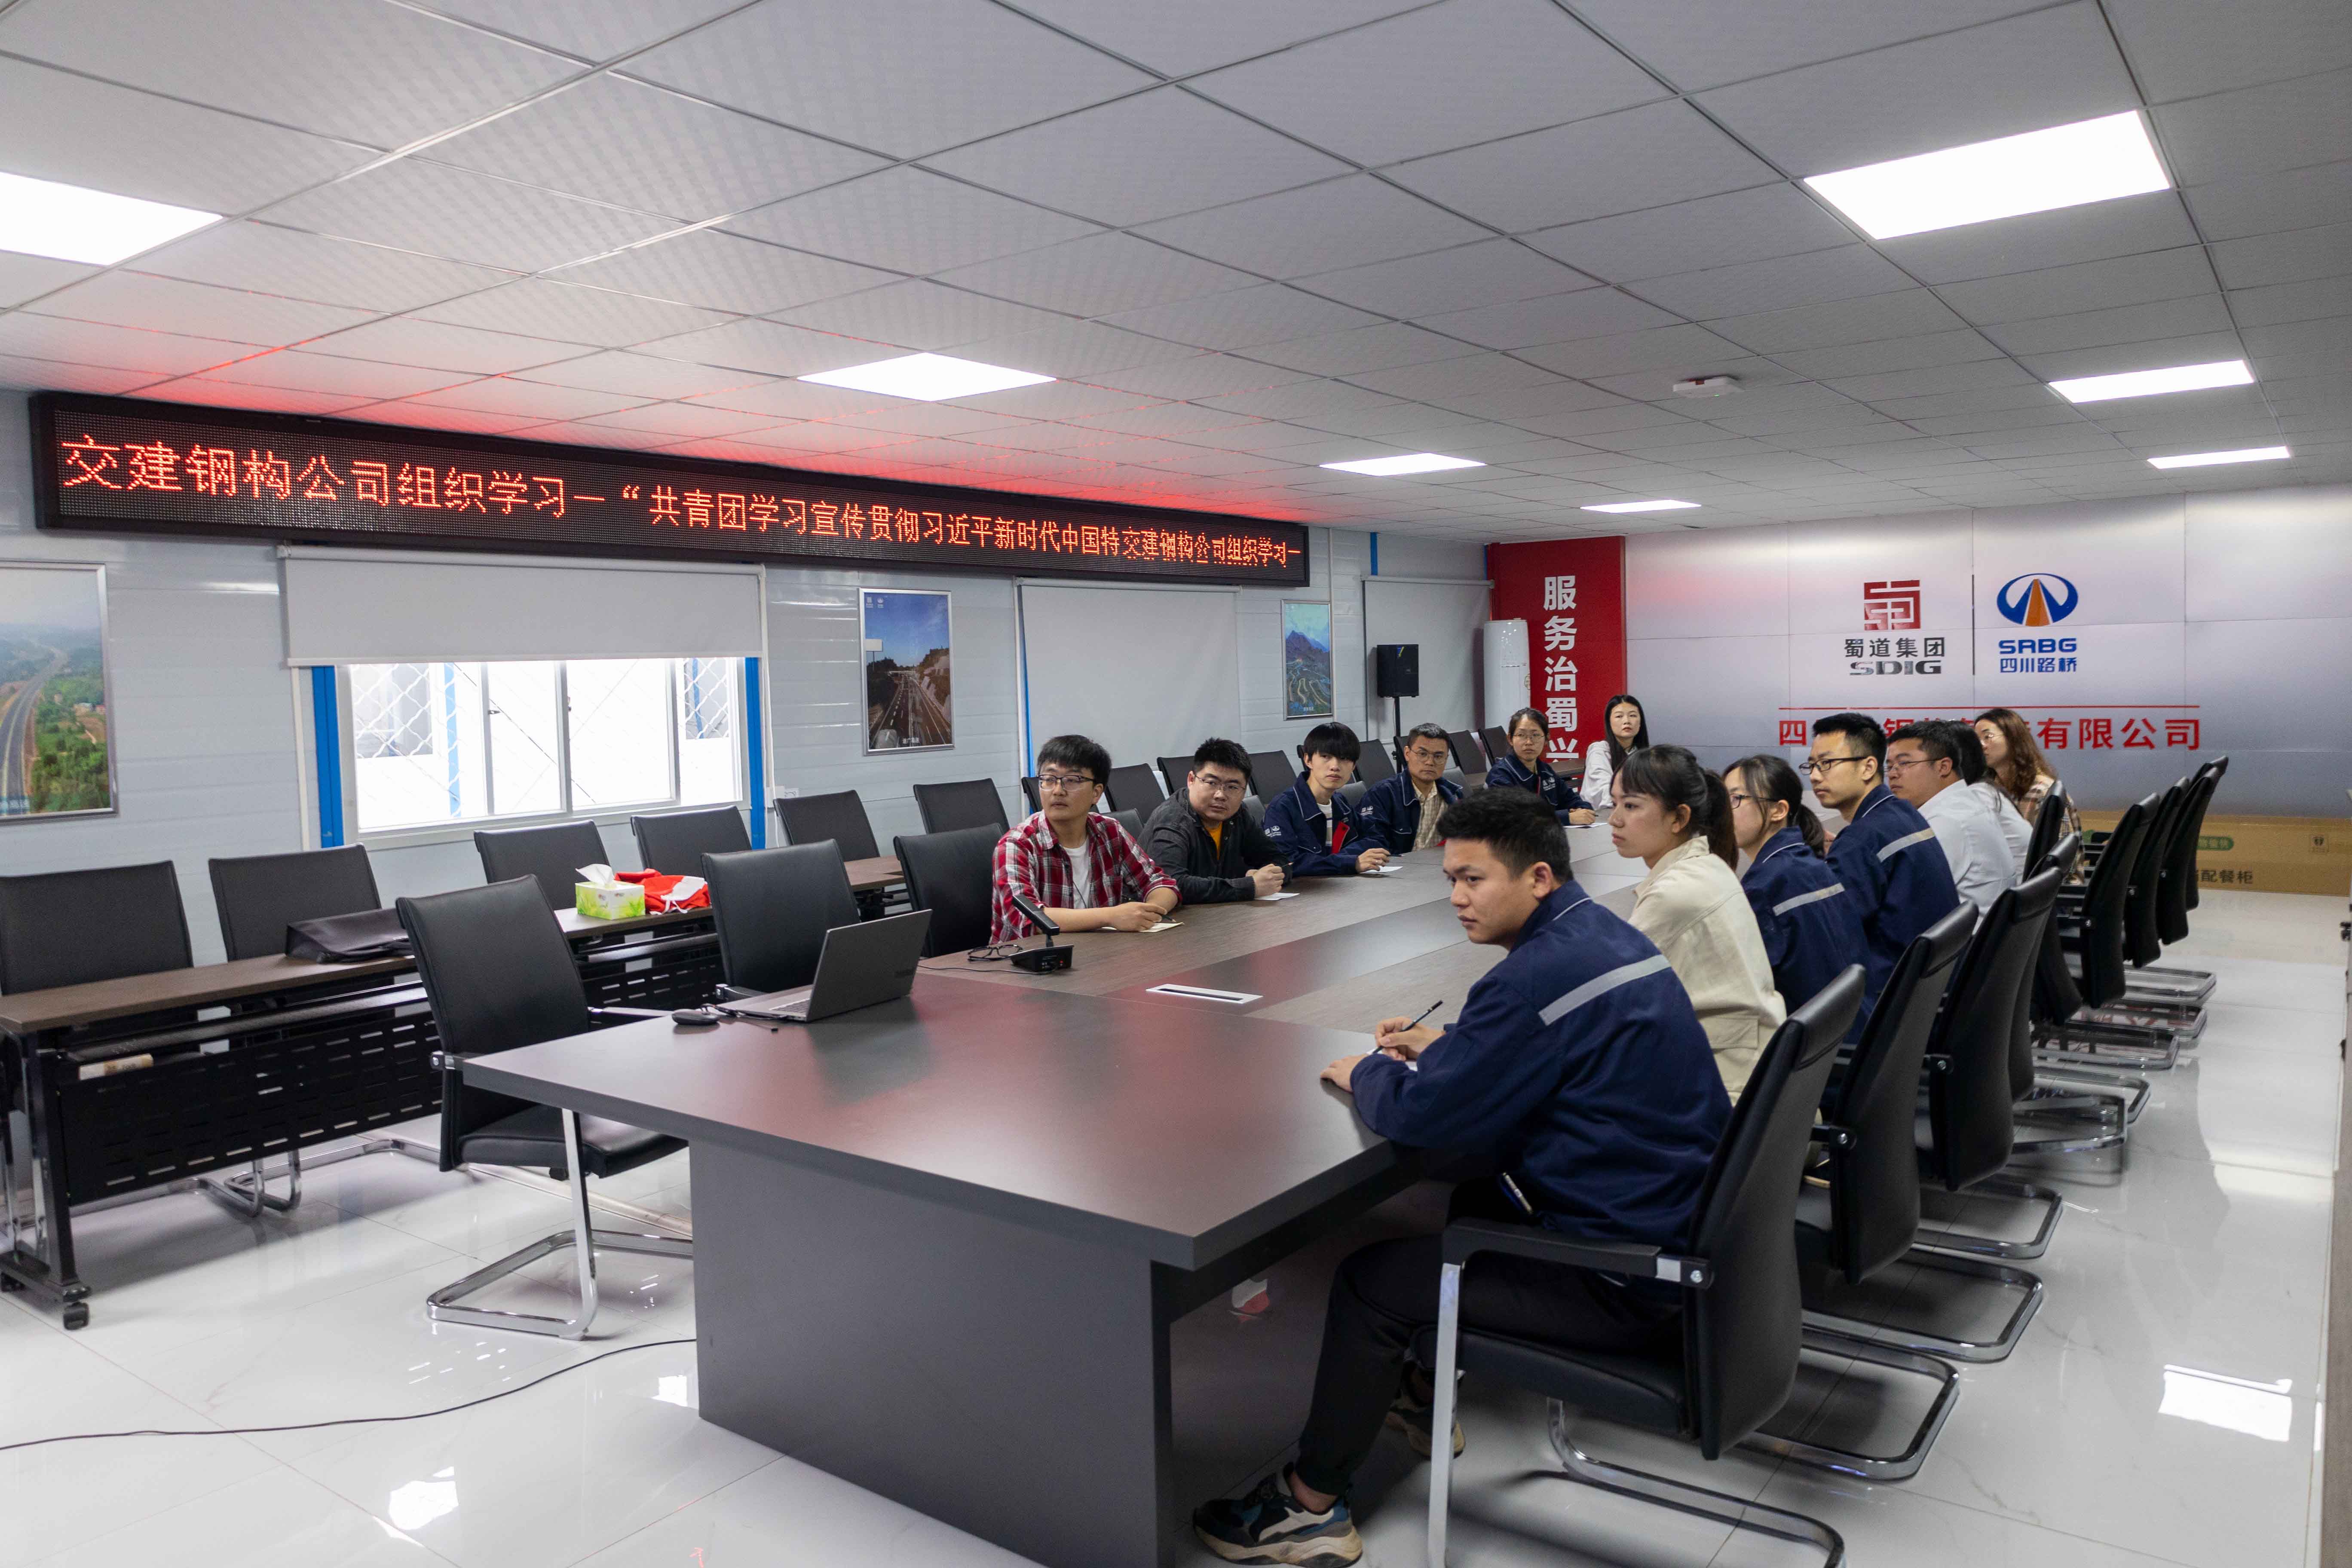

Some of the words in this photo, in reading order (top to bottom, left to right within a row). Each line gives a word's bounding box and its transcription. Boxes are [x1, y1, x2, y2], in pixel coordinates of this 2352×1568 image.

[1844, 637, 1945, 658] 蜀道集团
[1850, 660, 1942, 675] SDIG
[2000, 657, 2077, 673] 四川路桥
[2196, 869, 2253, 884] 配餐柜
